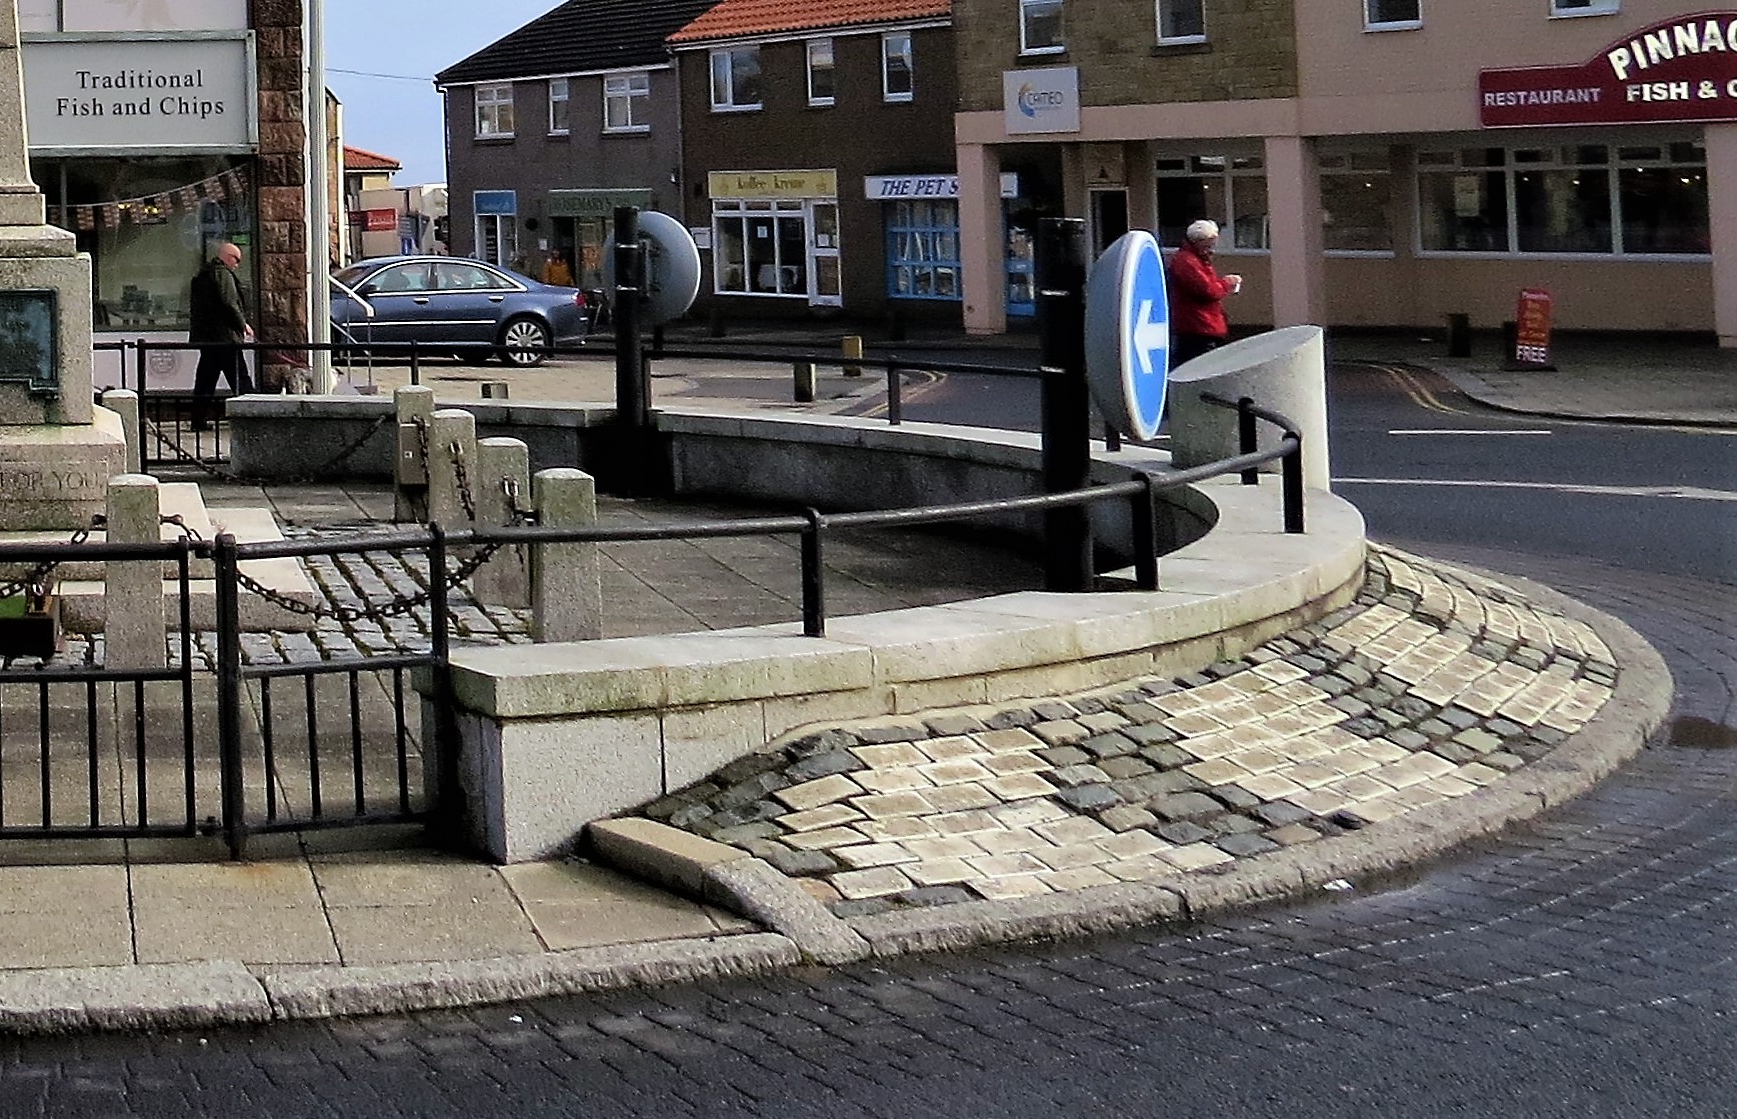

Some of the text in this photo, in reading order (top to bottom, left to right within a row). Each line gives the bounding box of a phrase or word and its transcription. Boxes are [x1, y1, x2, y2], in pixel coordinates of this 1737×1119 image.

[75, 69, 204, 89] Traditional
[1484, 87, 1601, 107] RESTAURANT
[1626, 81, 1689, 103] FISH
[1697, 79, 1718, 100] &
[56, 96, 225, 120] Fish and Chips
[881, 179, 910, 196] THE
[914, 179, 946, 195] PET
[51, 471, 101, 491] YOU
